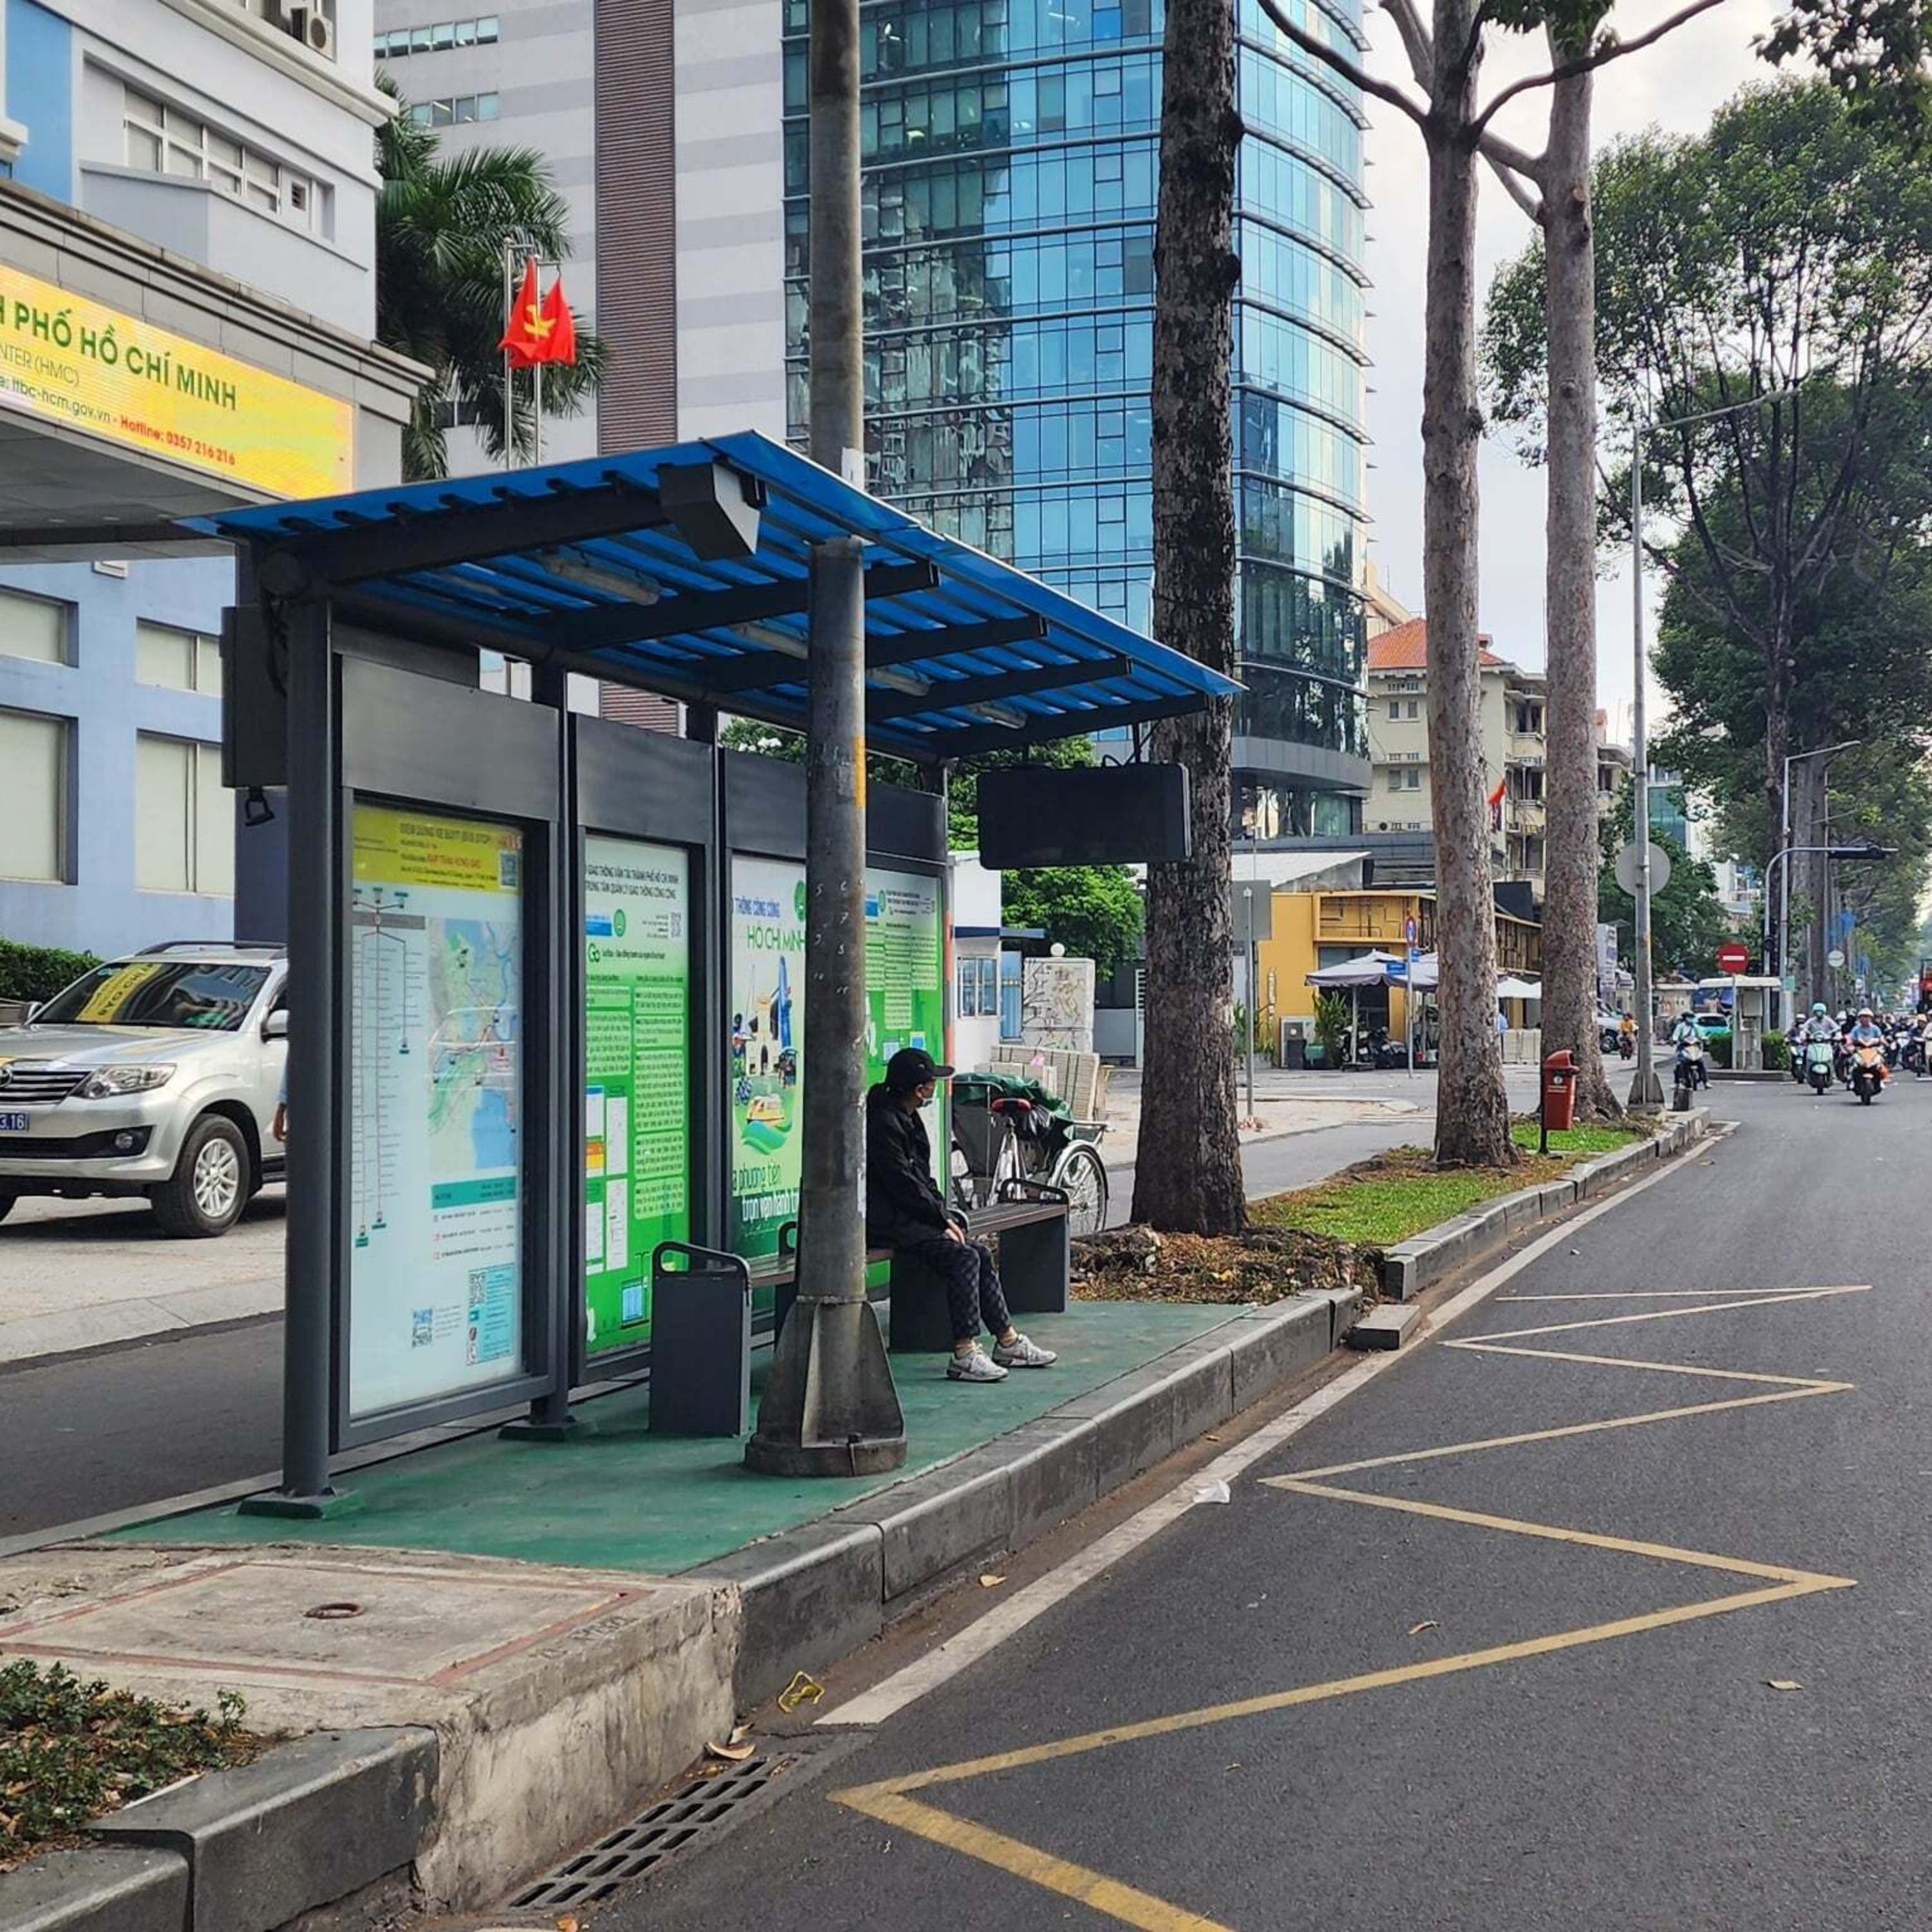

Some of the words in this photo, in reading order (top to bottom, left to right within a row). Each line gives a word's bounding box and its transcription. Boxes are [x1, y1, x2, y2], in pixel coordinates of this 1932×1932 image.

[15, 301, 72, 348] PHỐ
[80, 324, 118, 365] HỒ
[126, 346, 171, 386] CHÍ
[176, 365, 236, 411] MINH
[35, 355, 80, 388] (HMC)
[120, 415, 164, 442] Hotline:
[166, 431, 192, 451] 0357
[195, 440, 214, 459] 216
[216, 448, 236, 466] 216
